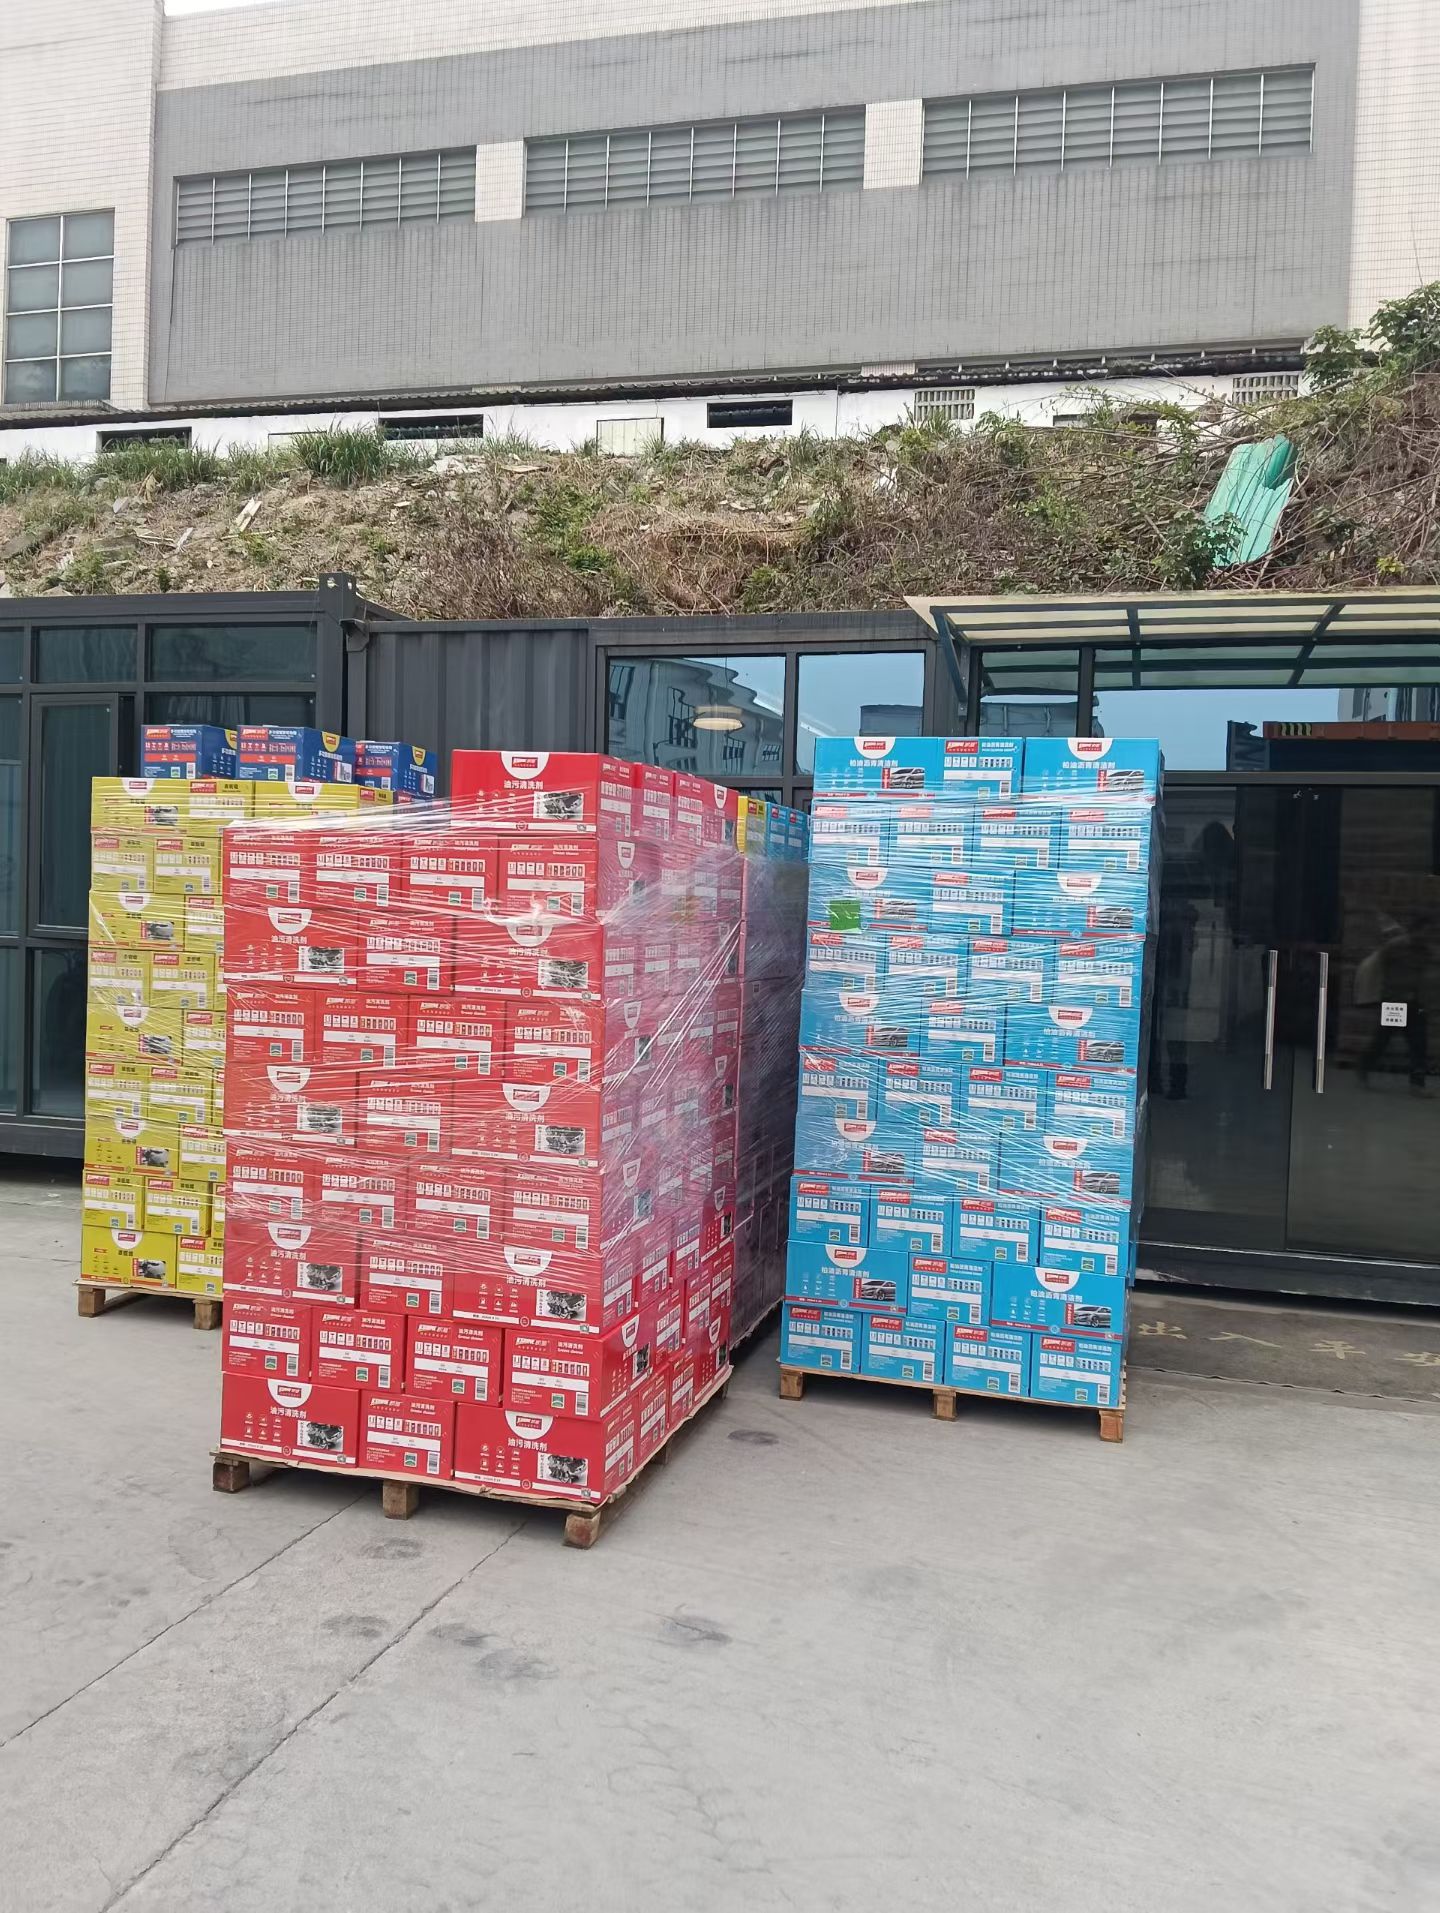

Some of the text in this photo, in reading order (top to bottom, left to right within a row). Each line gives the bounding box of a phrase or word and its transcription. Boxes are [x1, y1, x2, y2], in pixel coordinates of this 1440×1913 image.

[503, 780, 544, 790] 油污清洗剂
[270, 1250, 307, 1261] 油污清洗剂
[506, 1275, 547, 1287] 油污清洗剂
[270, 1406, 307, 1419] 油污清洗剂
[507, 1438, 548, 1452] 油污清洗剂
